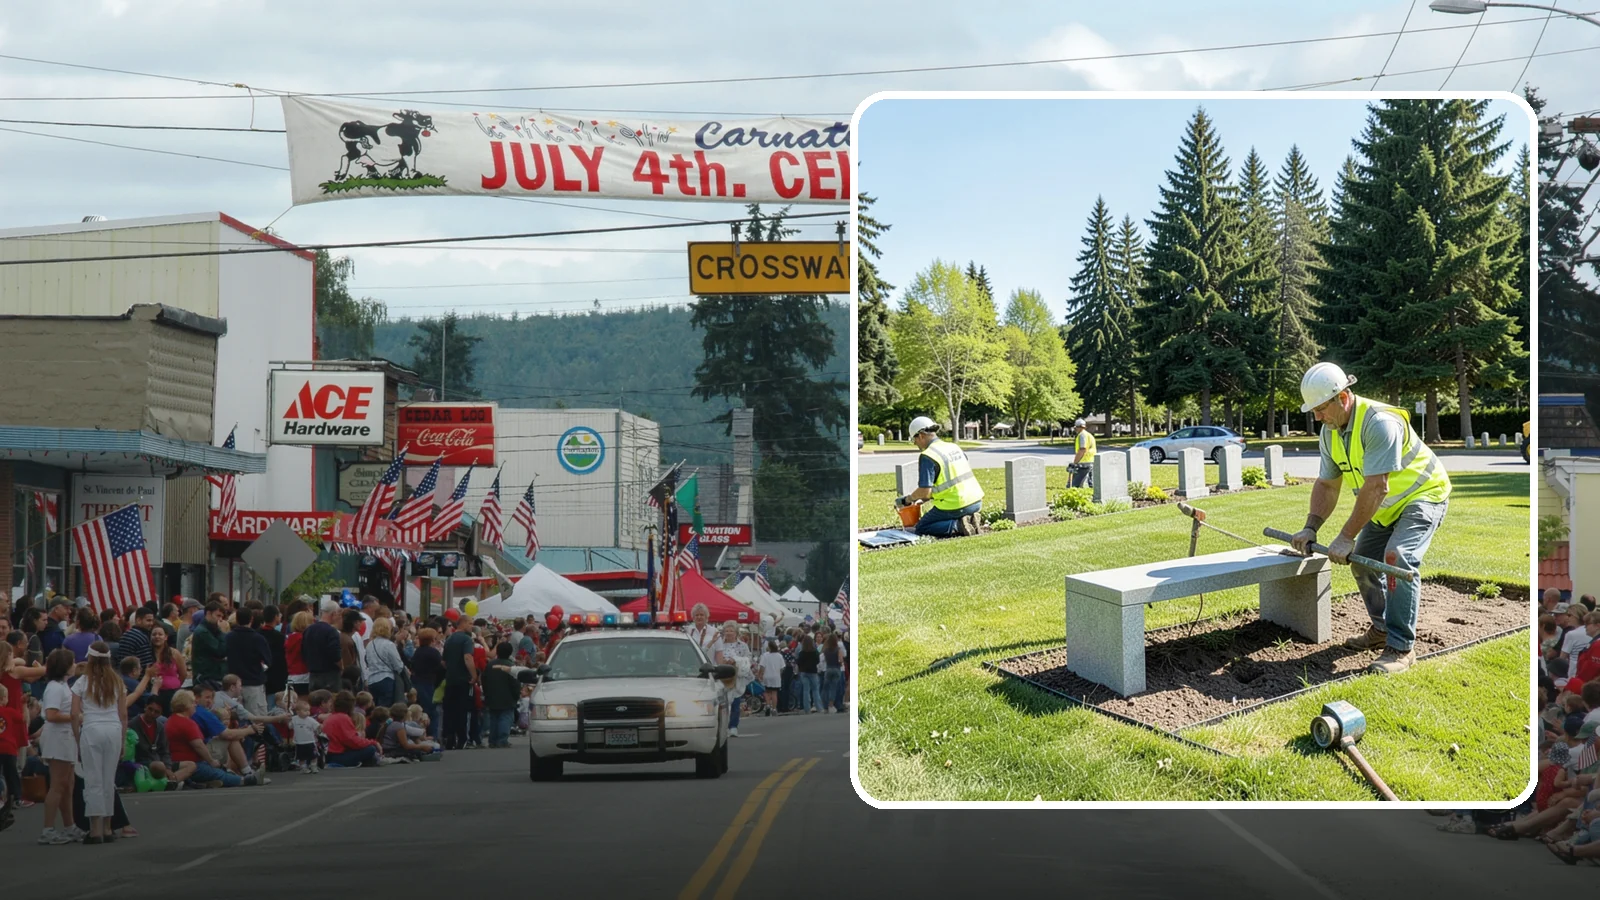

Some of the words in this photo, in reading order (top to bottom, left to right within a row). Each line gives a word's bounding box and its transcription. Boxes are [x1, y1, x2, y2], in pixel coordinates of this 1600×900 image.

[482, 141, 604, 192] JULY
[633, 150, 746, 197] 4th.
[697, 254, 850, 279] CROSSWA
[283, 380, 373, 420] ACE
[406, 409, 452, 421] CEDAR
[284, 421, 371, 436] Hardware
[417, 428, 476, 446] Coca-Cola
[353, 467, 387, 480] Simpl
[83, 485, 93, 495] St.
[95, 485, 124, 495] Vincent
[126, 485, 136, 495] de
[138, 486, 155, 495] Paul
[700, 535, 730, 543] GLASS
